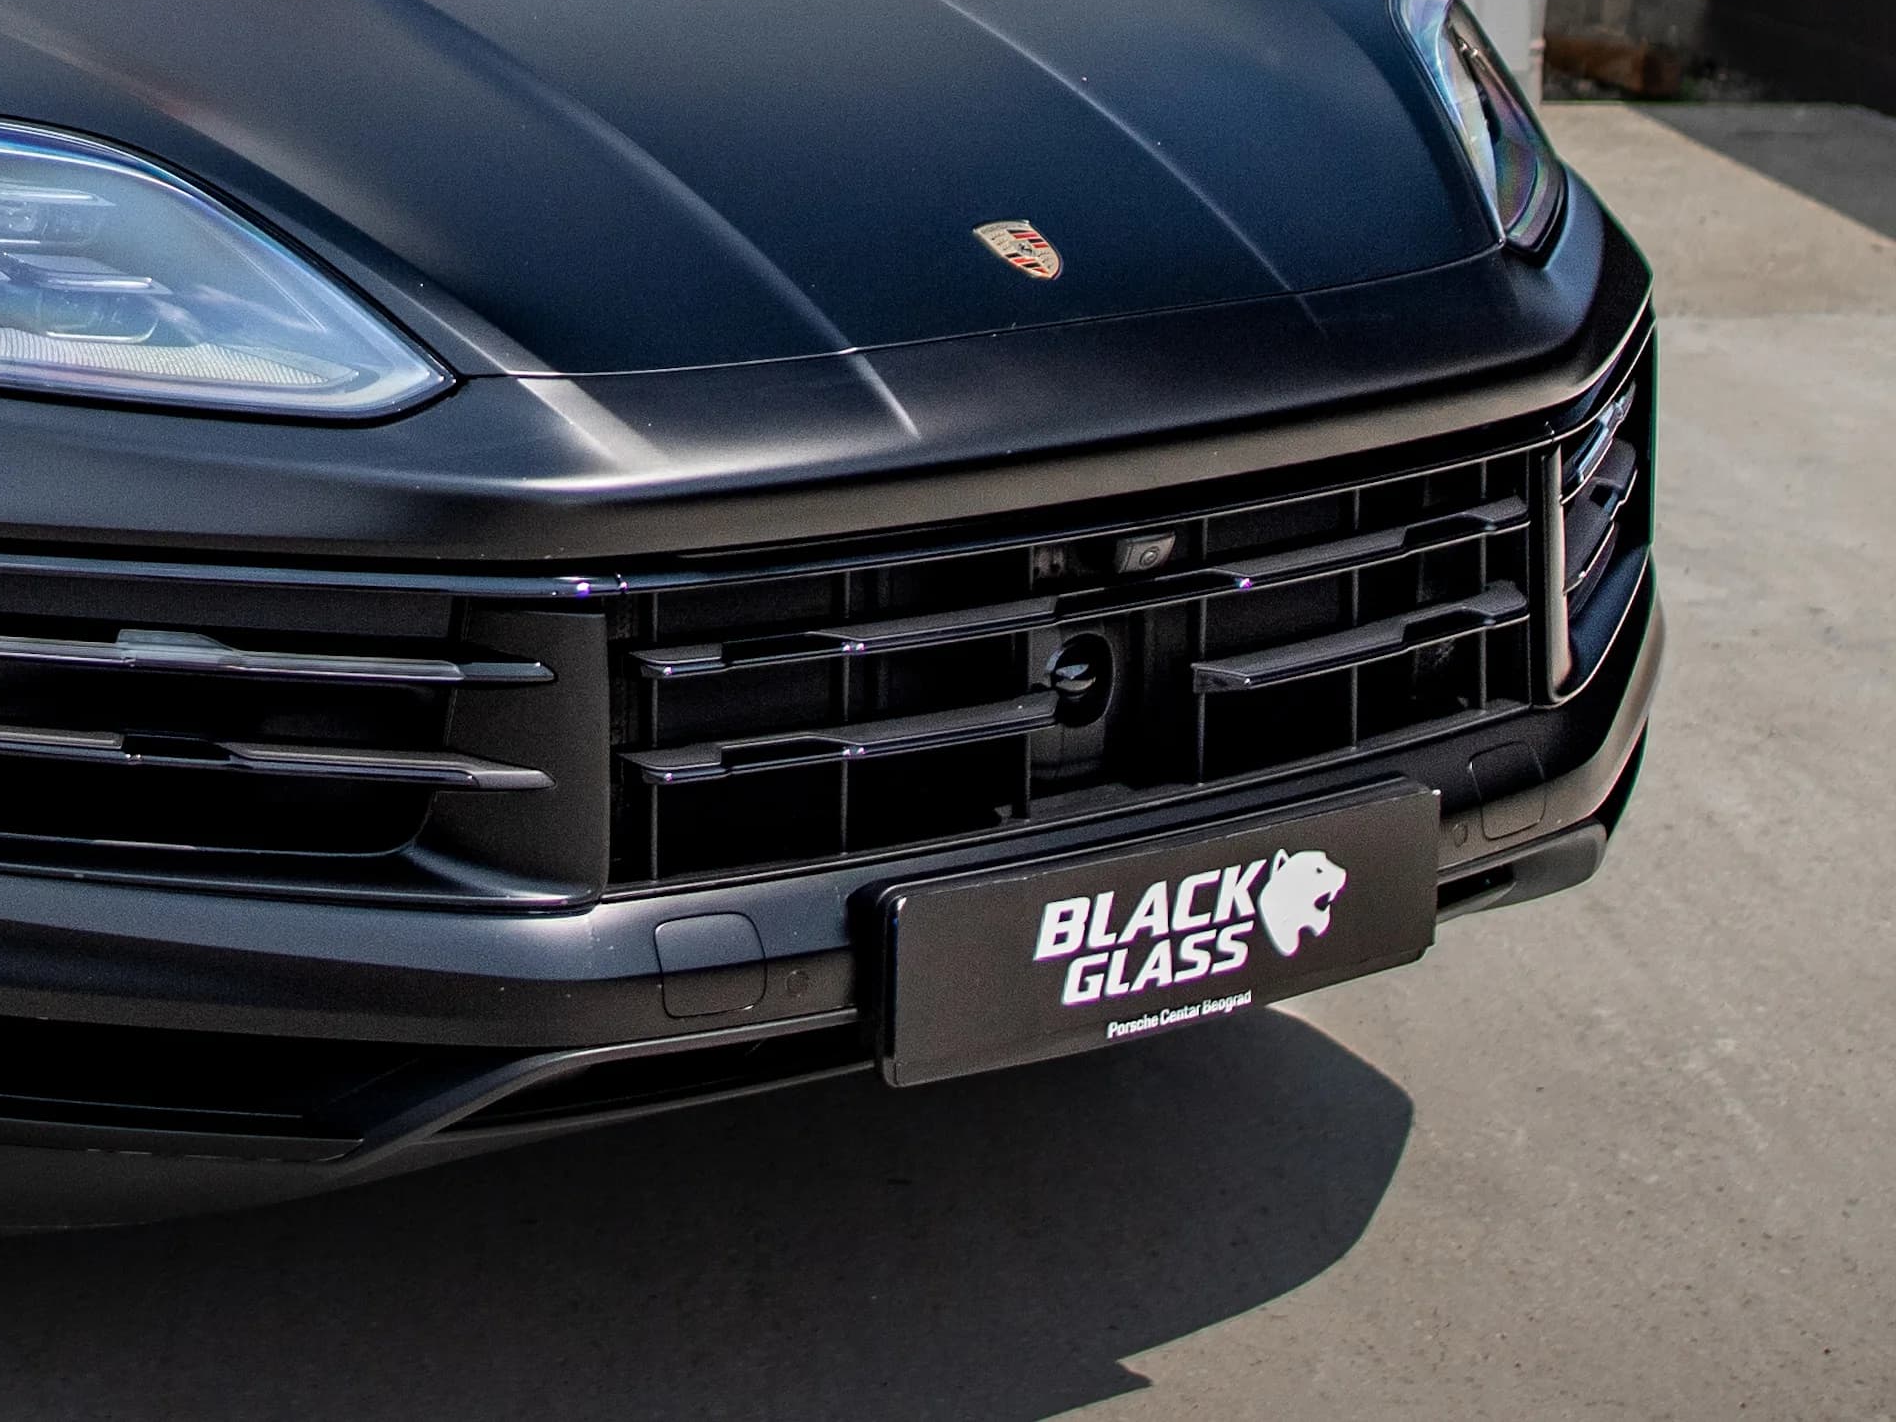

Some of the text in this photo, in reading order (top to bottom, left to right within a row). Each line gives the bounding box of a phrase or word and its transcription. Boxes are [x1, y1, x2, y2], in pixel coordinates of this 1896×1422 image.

[1034, 858, 1267, 961] BLACK
[1062, 921, 1254, 1006] GLASS
[1107, 989, 1252, 1039] Porsche Centar Beograd
